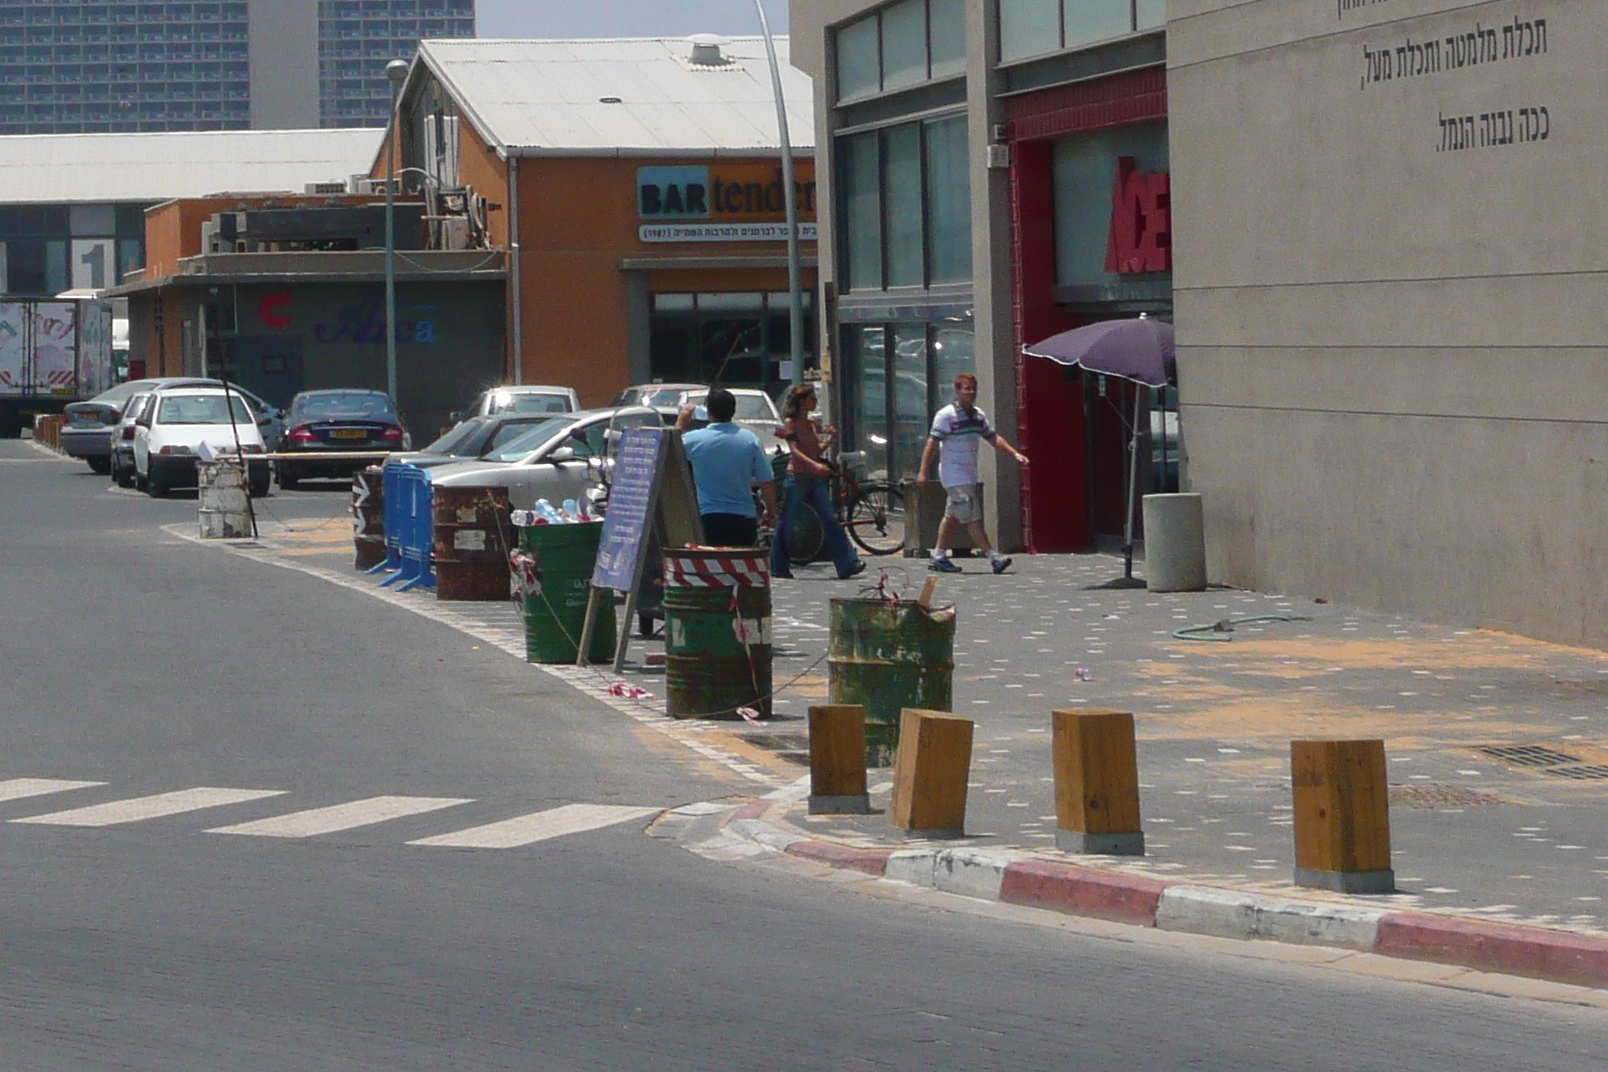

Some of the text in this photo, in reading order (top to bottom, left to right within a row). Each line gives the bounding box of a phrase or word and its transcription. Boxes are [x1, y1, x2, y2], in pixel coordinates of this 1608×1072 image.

[1361, 15, 1547, 90] תכלת מלמטה ותכלת מעל,
[1436, 106, 1550, 152] ככה נבנה הנמל.
[81, 243, 104, 289] 1
